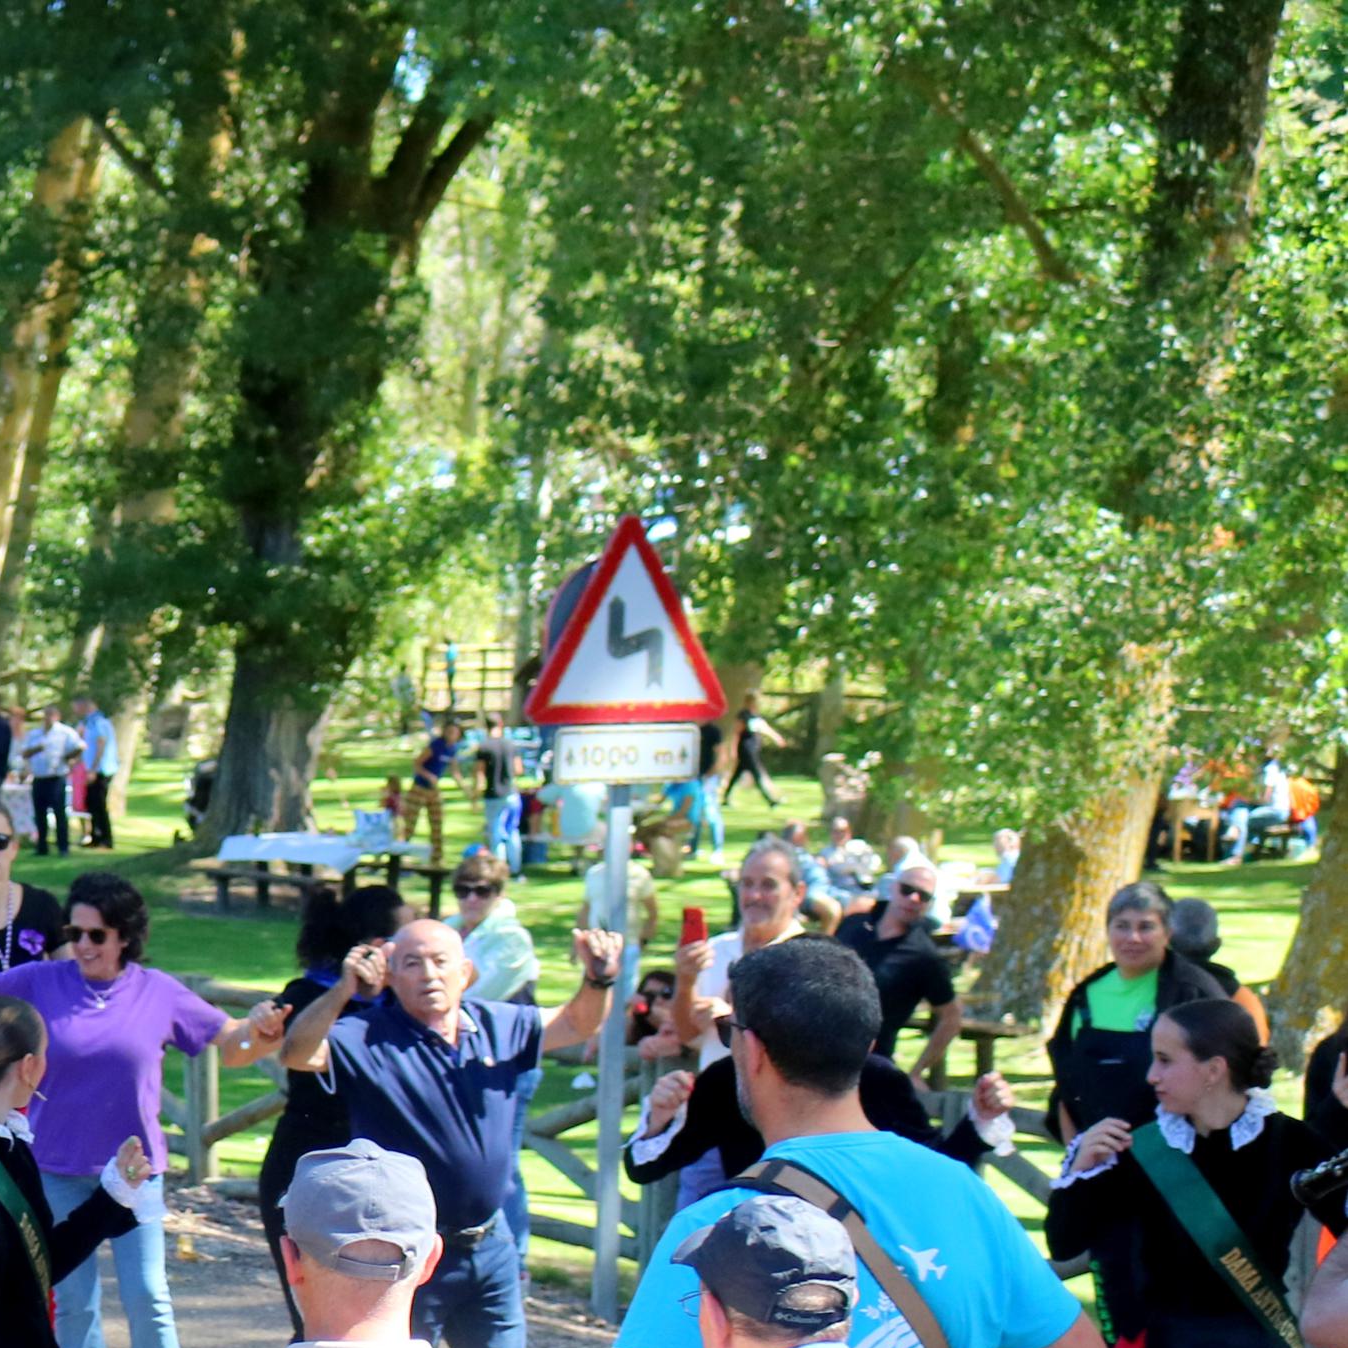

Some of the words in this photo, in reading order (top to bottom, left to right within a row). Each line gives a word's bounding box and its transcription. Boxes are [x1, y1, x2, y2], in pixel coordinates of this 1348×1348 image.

[580, 744, 638, 767] 1000
[654, 748, 674, 765] m
[1219, 1246, 1262, 1293] DAMA
